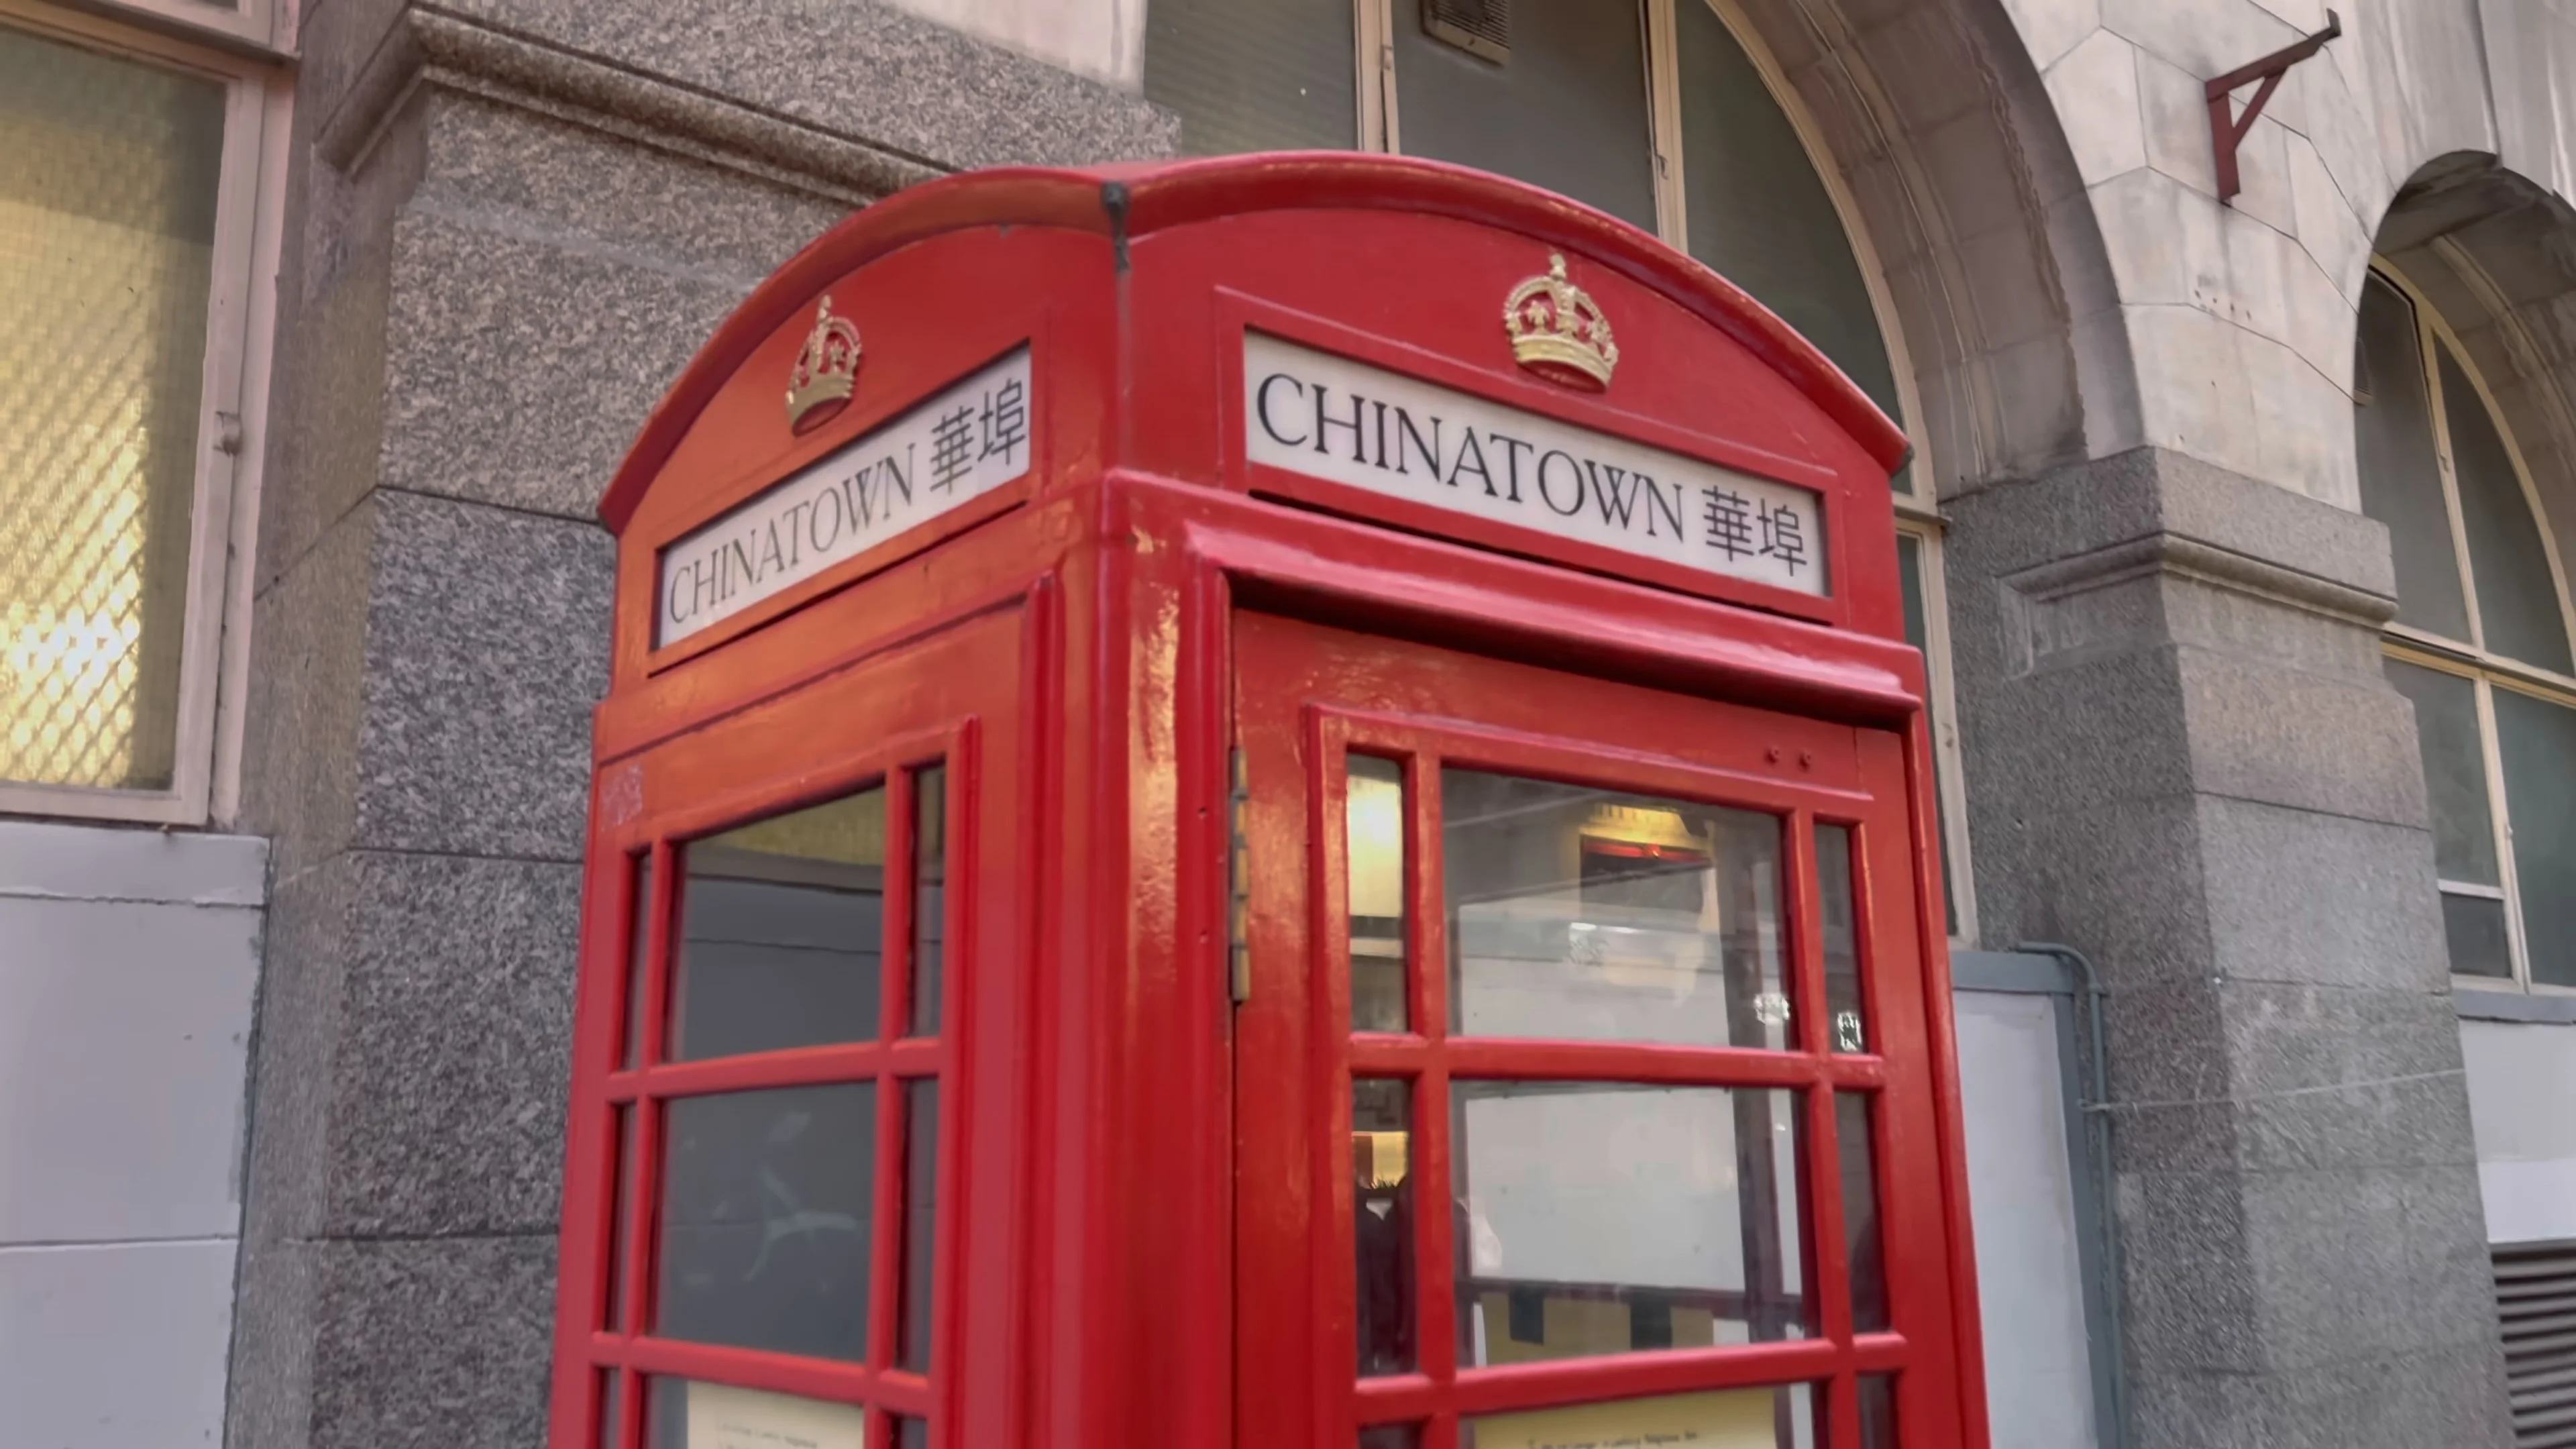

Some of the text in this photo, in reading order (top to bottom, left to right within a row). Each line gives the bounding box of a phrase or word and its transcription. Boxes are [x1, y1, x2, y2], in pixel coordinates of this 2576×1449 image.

[669, 378, 1026, 624] CHINATOWN 華埠
[1256, 372, 1808, 577] CHINATOWN 華埠
